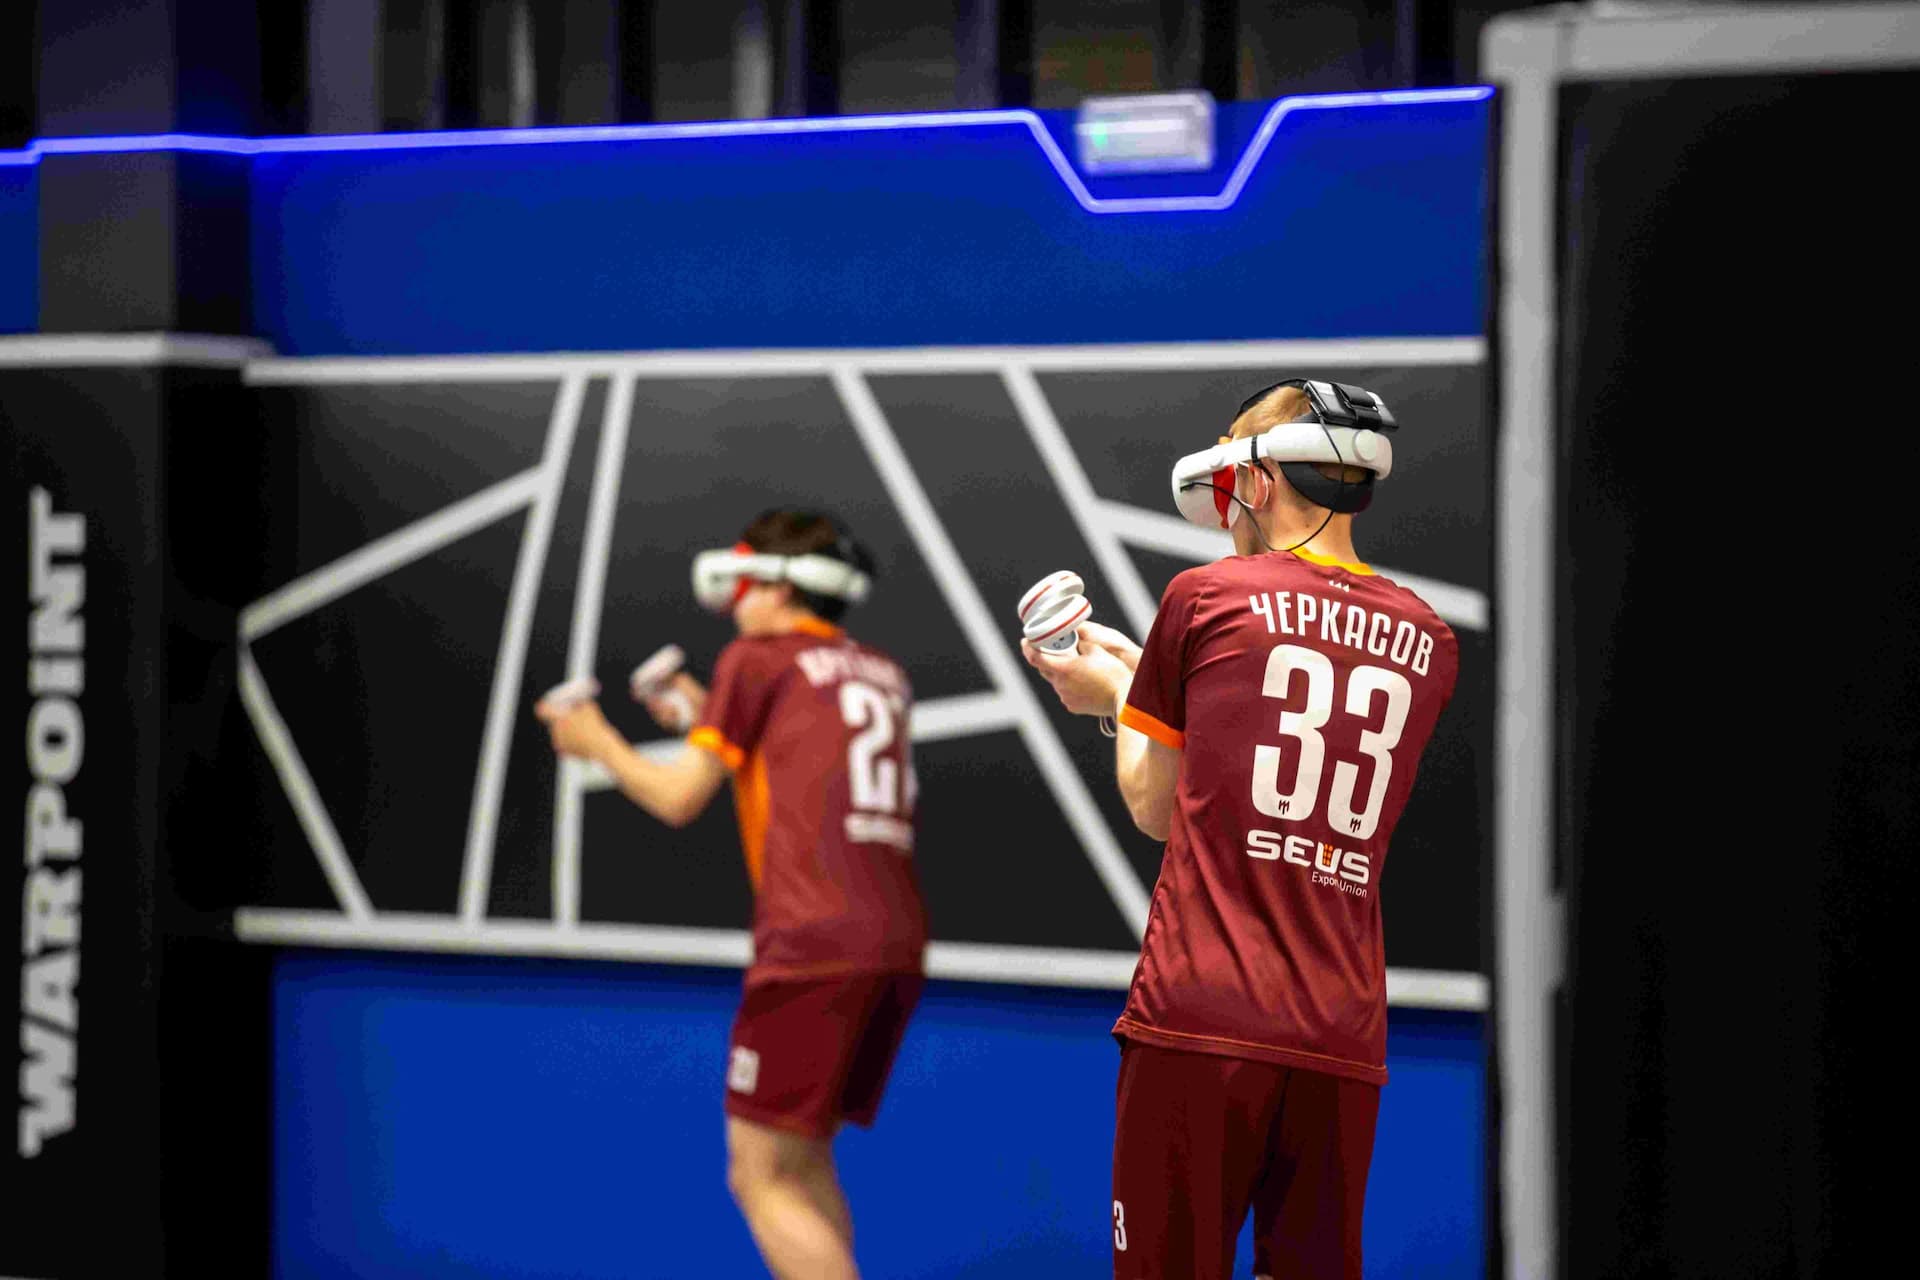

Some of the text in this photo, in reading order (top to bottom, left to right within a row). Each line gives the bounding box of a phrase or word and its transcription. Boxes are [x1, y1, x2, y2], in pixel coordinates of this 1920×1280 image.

[1248, 590, 1434, 677] ЧЕРКАСОВ
[1252, 643, 1412, 840] 33
[20, 485, 87, 1159] WARPOINT
[1246, 829, 1370, 884] SEUS
[1340, 880, 1368, 898] Union
